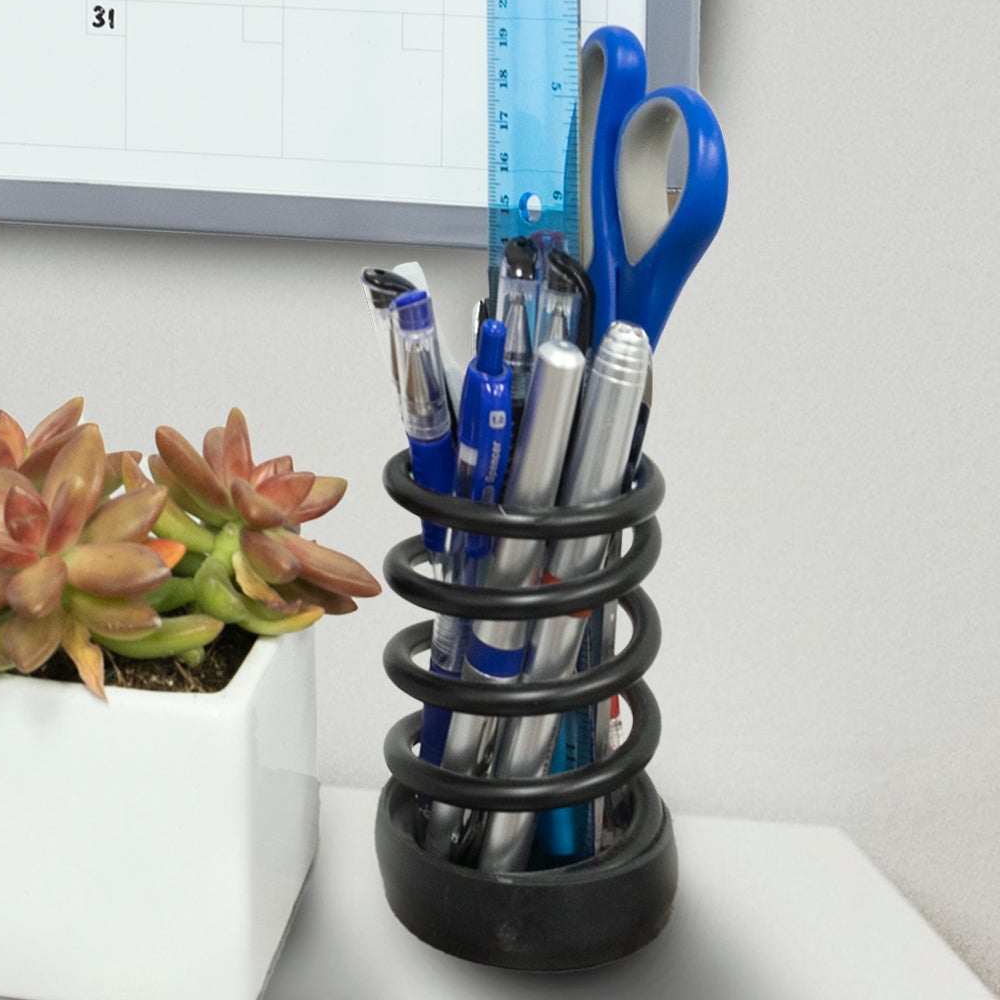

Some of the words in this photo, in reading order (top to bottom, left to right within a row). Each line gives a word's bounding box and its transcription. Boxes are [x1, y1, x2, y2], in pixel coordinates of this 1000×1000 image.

[92, 5, 115, 30] 31
[499, 28, 508, 47] 19
[499, 69, 508, 89] 18
[499, 111, 509, 130] 17
[500, 152, 509, 172] 16
